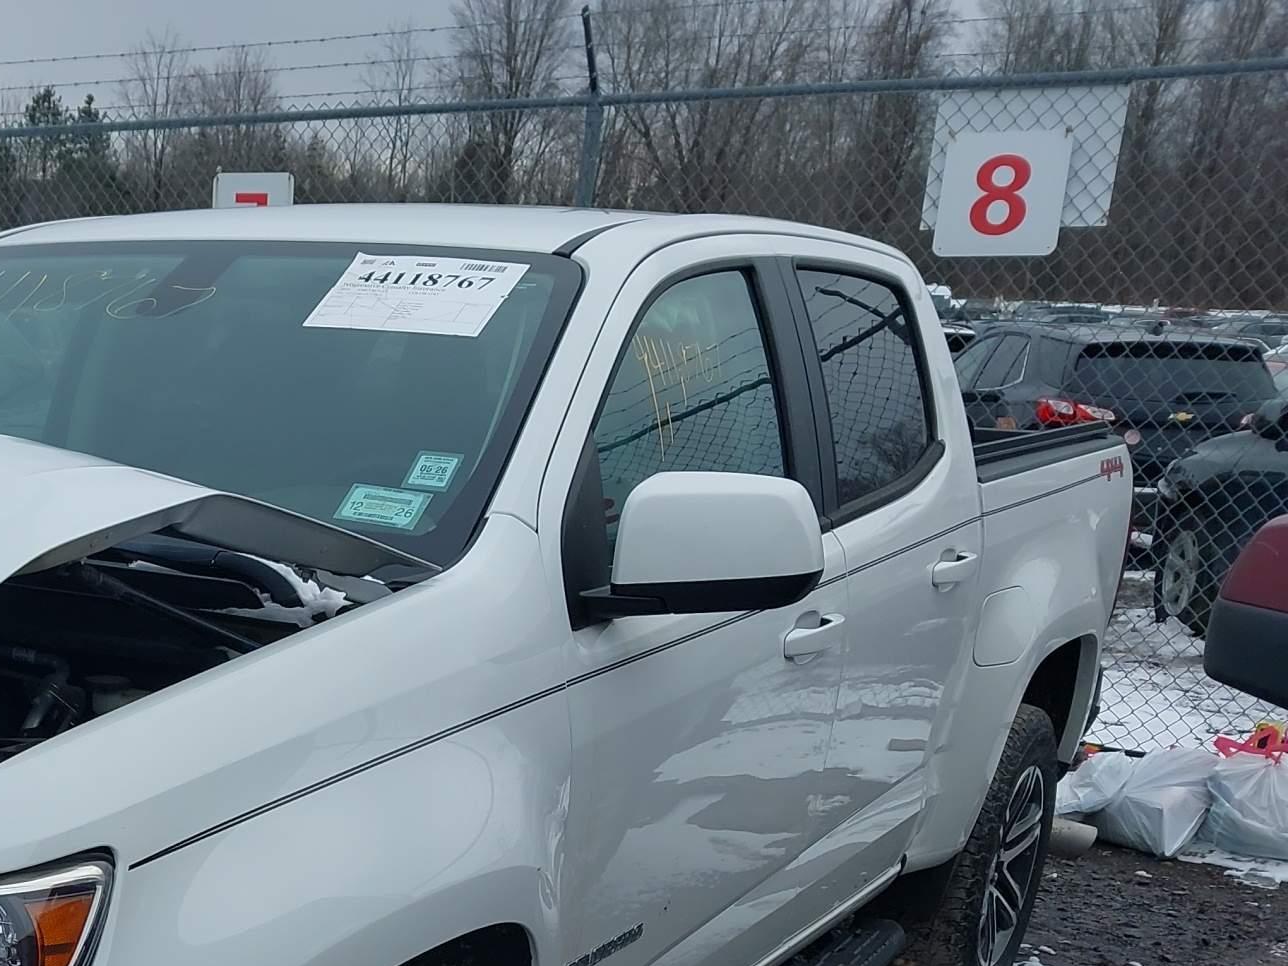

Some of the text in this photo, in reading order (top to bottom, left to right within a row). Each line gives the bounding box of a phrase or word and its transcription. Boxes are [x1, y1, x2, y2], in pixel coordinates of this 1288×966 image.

[969, 153, 1032, 237] 8
[358, 270, 496, 291] 44118767
[350, 500, 364, 511] 12
[395, 507, 415, 518] 26
